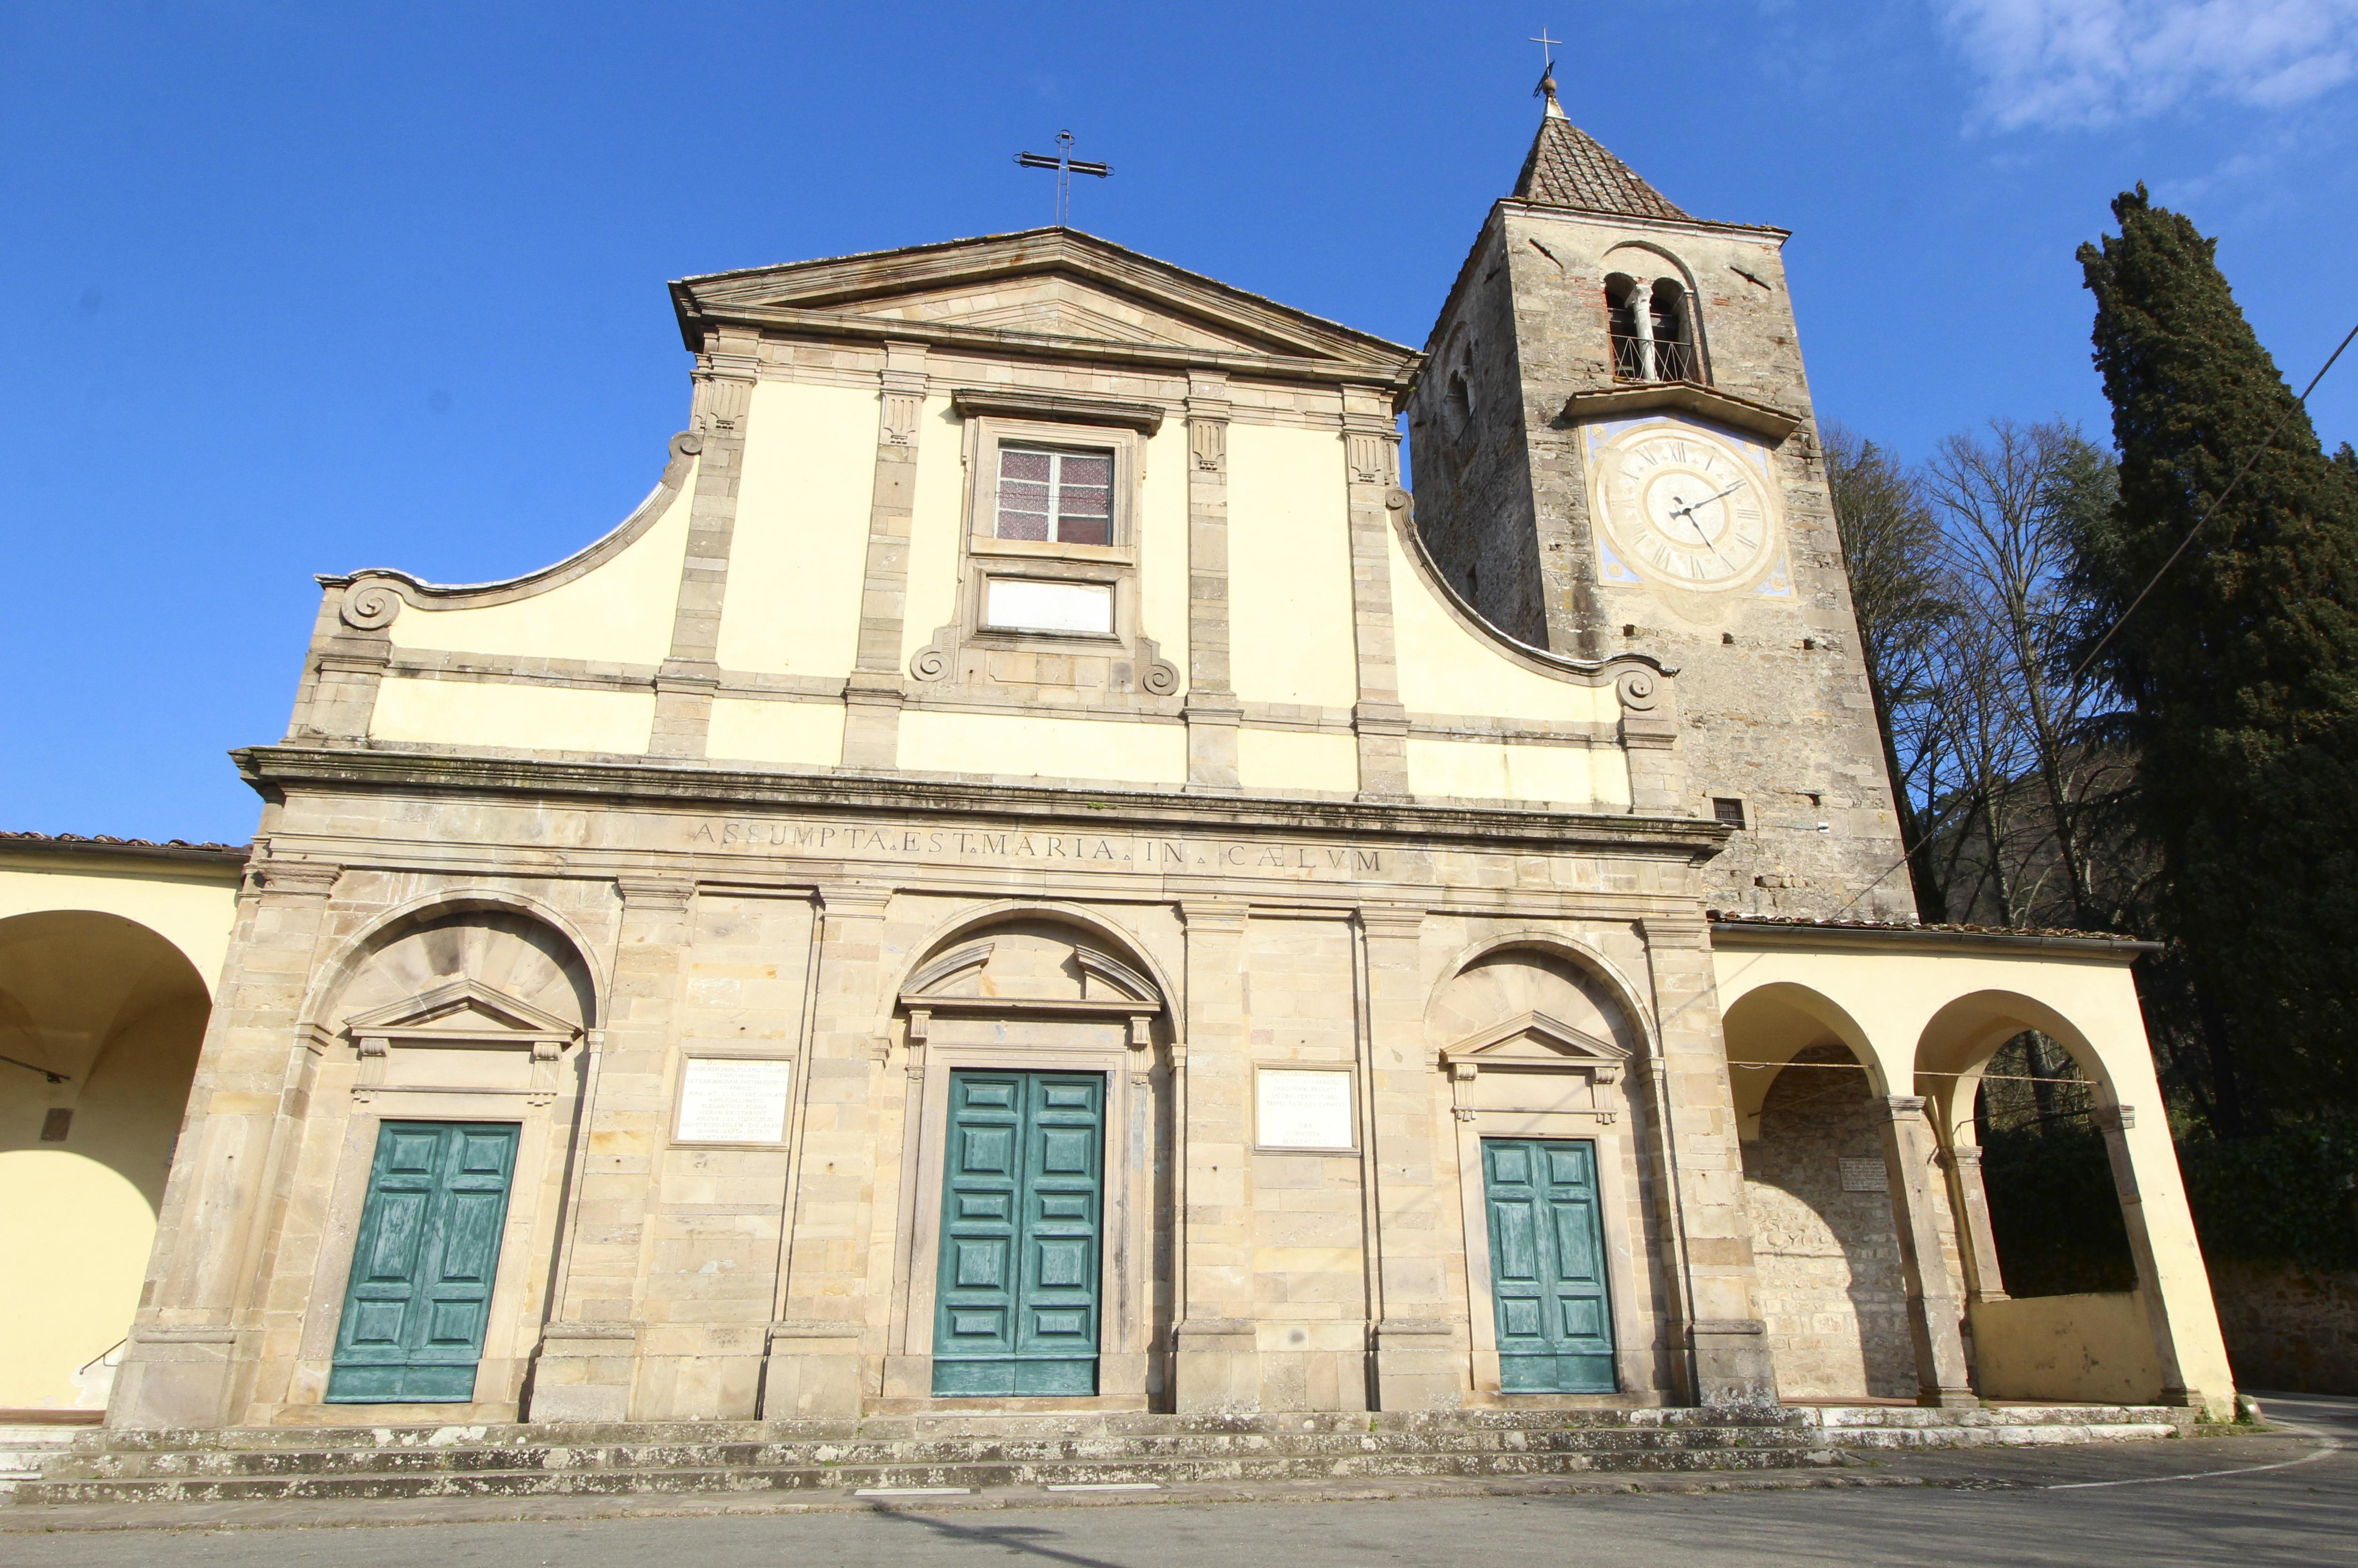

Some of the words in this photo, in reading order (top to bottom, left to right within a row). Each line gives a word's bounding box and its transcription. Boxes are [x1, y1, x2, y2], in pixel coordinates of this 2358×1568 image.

[1667, 441, 1687, 463] XII
[1737, 508, 1761, 520] III
[903, 832, 970, 854] EST
[981, 833, 1115, 860] MARIA
[1146, 841, 1184, 863] IN
